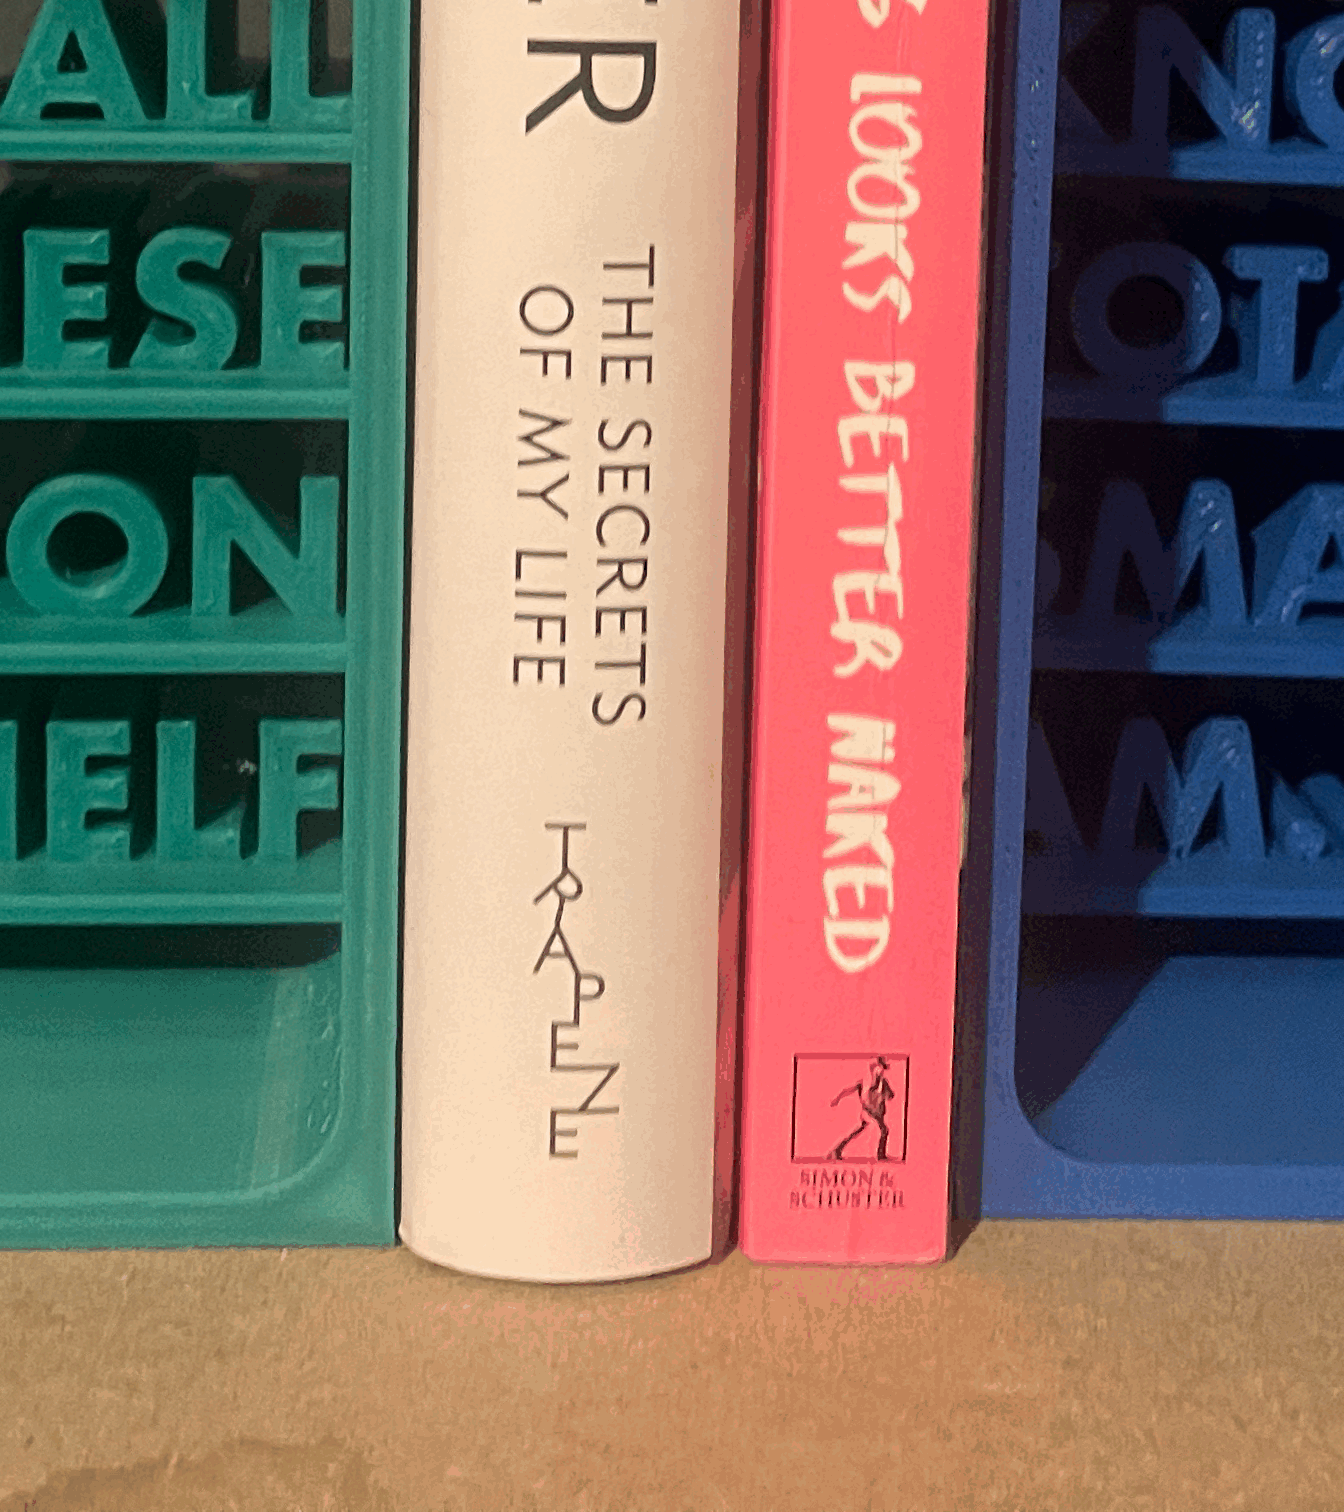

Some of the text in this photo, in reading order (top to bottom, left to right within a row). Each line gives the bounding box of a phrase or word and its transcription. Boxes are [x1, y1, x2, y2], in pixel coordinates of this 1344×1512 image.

[842, 71, 923, 325] LOOKS
[5, 472, 341, 619] ON
[512, 284, 575, 689] OF MY LIFE
[591, 243, 655, 726] THE SECRETS
[830, 359, 916, 678] BETTER
[533, 820, 621, 1161] TRAPEZE
[822, 712, 902, 974] NAKED
